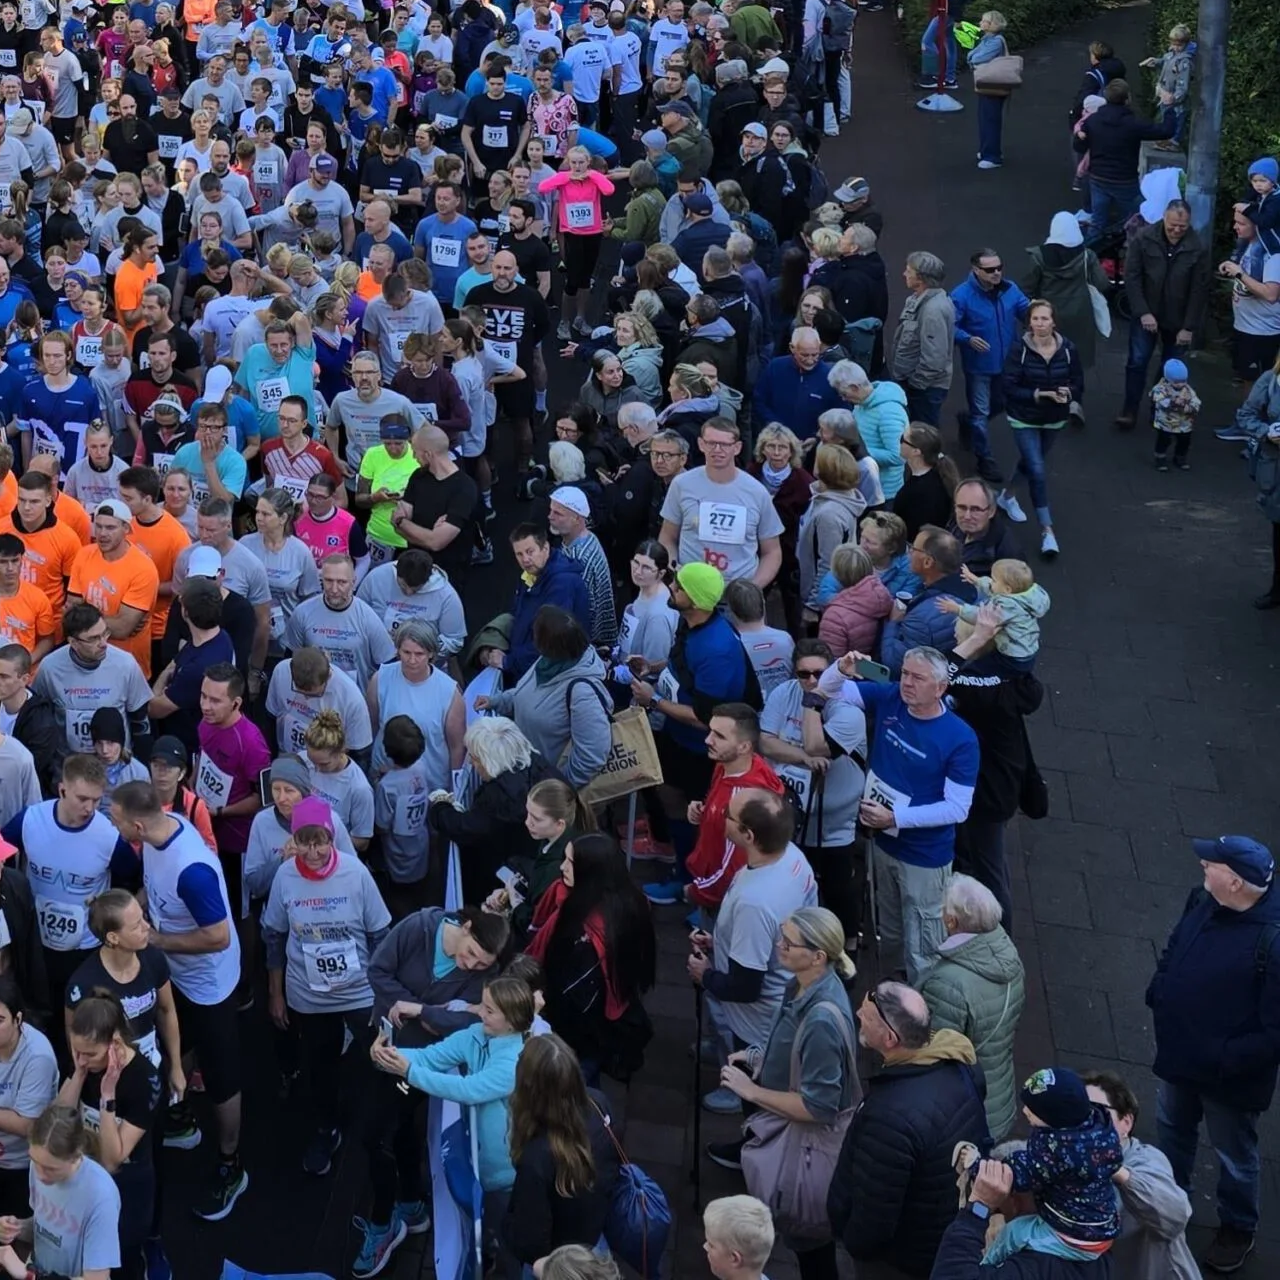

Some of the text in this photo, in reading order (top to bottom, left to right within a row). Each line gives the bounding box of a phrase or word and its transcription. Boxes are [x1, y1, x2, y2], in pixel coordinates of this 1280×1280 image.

[569, 209, 592, 218] 1393
[434, 245, 456, 256] 1796
[261, 387, 283, 400] 345
[709, 512, 736, 527] 277
[319, 628, 359, 636] INTERSPORT
[199, 766, 225, 797] 1822
[301, 896, 348, 908] INTERSPORT
[39, 911, 78, 934] 1249
[316, 954, 348, 973] 993
